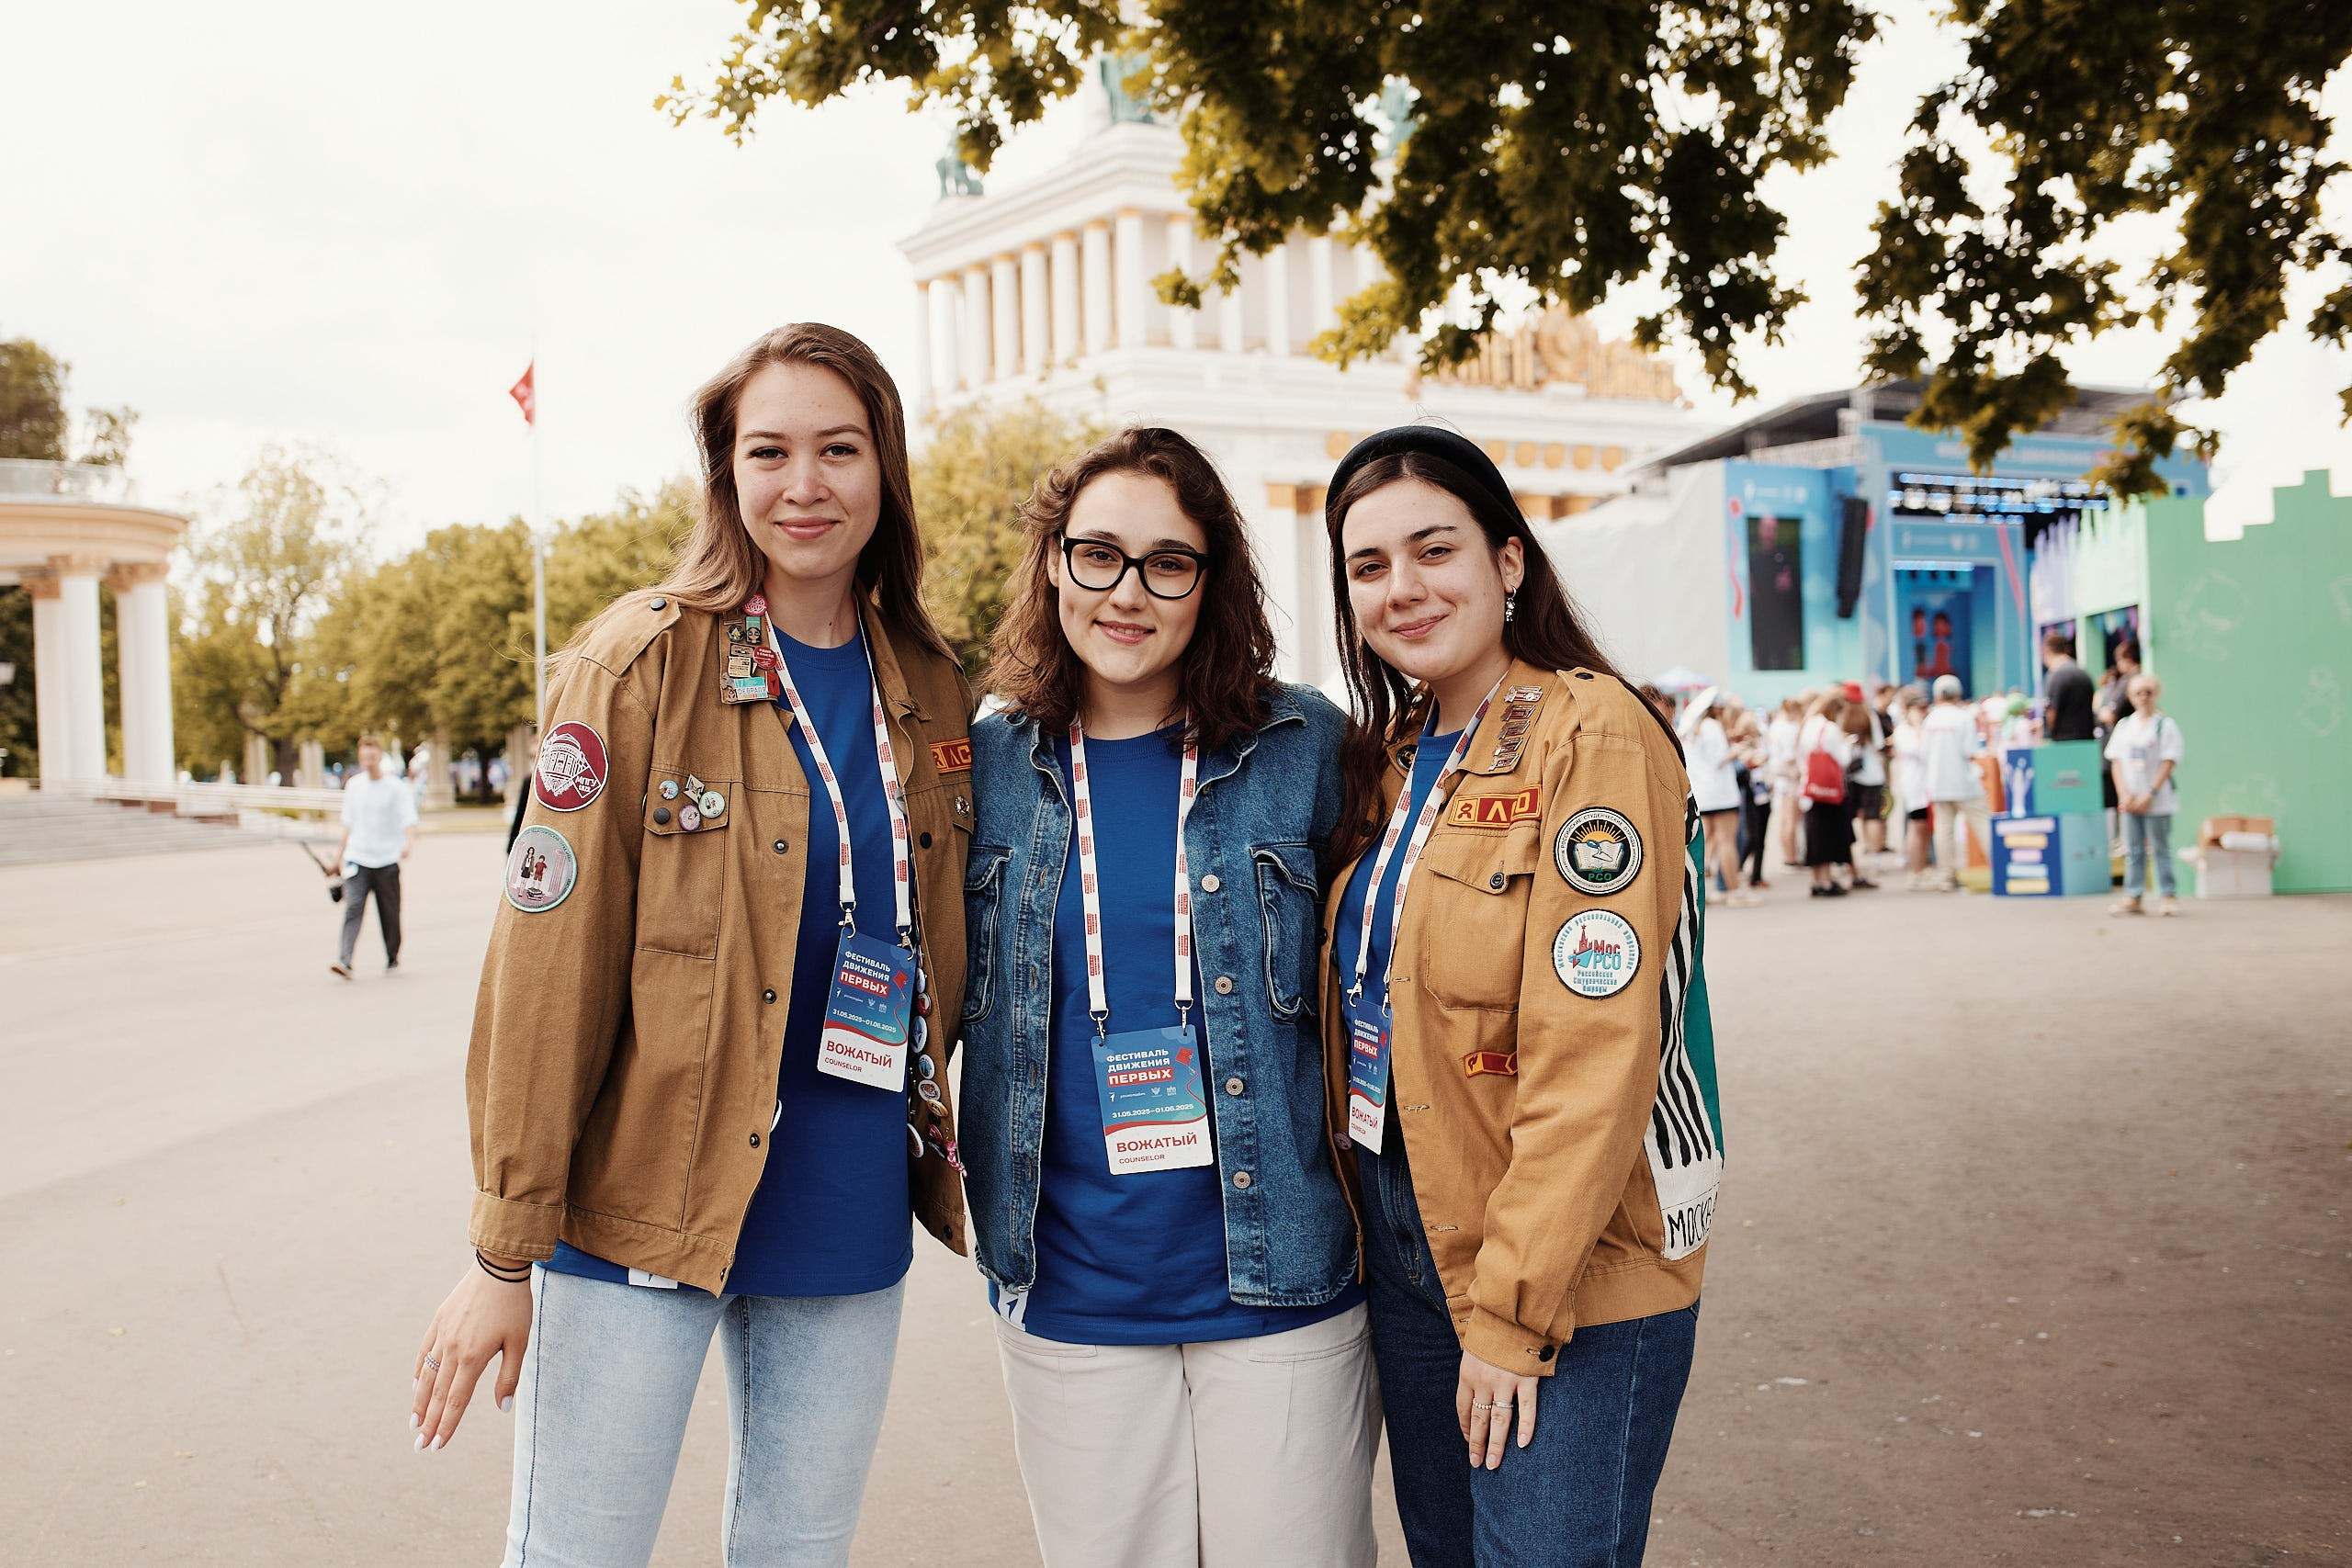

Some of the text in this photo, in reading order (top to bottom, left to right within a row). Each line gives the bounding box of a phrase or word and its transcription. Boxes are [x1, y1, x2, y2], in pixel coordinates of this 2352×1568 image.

[1588, 873, 1612, 881] РСО
[845, 950, 891, 973] ФЕСТИВАЛЬ
[1592, 953, 1622, 971] РСО
[842, 960, 890, 982] ДВИЖЕНИЯ
[840, 970, 888, 995] ПЕРВЫХ
[826, 1040, 893, 1068] ВОЖАТЫЙ
[1106, 1048, 1170, 1063] ФЕСТИВАЛЬ
[1353, 1039, 1378, 1057] ПЕРВЫХ
[824, 1056, 863, 1073] COUNSELOR
[1107, 1057, 1170, 1073] ДВИЖЕНИЯ
[1108, 1068, 1172, 1086] ПЕРВЫХ
[1351, 1106, 1378, 1130] ВОЖАТЫЙ
[1116, 1132, 1198, 1153] ВОЖАТЫЙ
[1118, 1154, 1166, 1164] COUNSELOR
